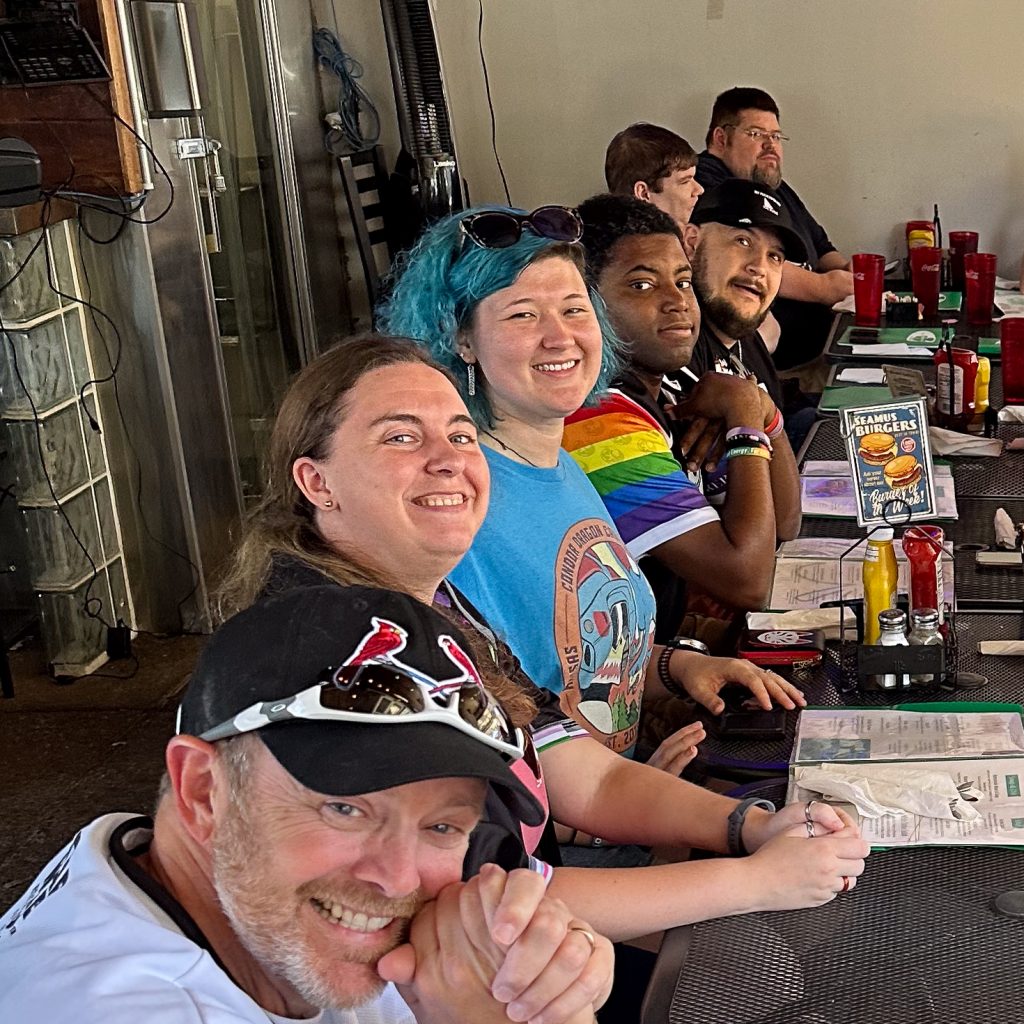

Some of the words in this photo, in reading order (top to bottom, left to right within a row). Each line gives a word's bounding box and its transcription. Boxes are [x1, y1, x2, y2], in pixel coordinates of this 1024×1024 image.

[854, 412, 898, 427] SEAMUS
[855, 419, 919, 437] BURGERS
[869, 487, 906, 504] Burger
[560, 543, 580, 594] CONDOR
[571, 524, 604, 549] DRAGON
